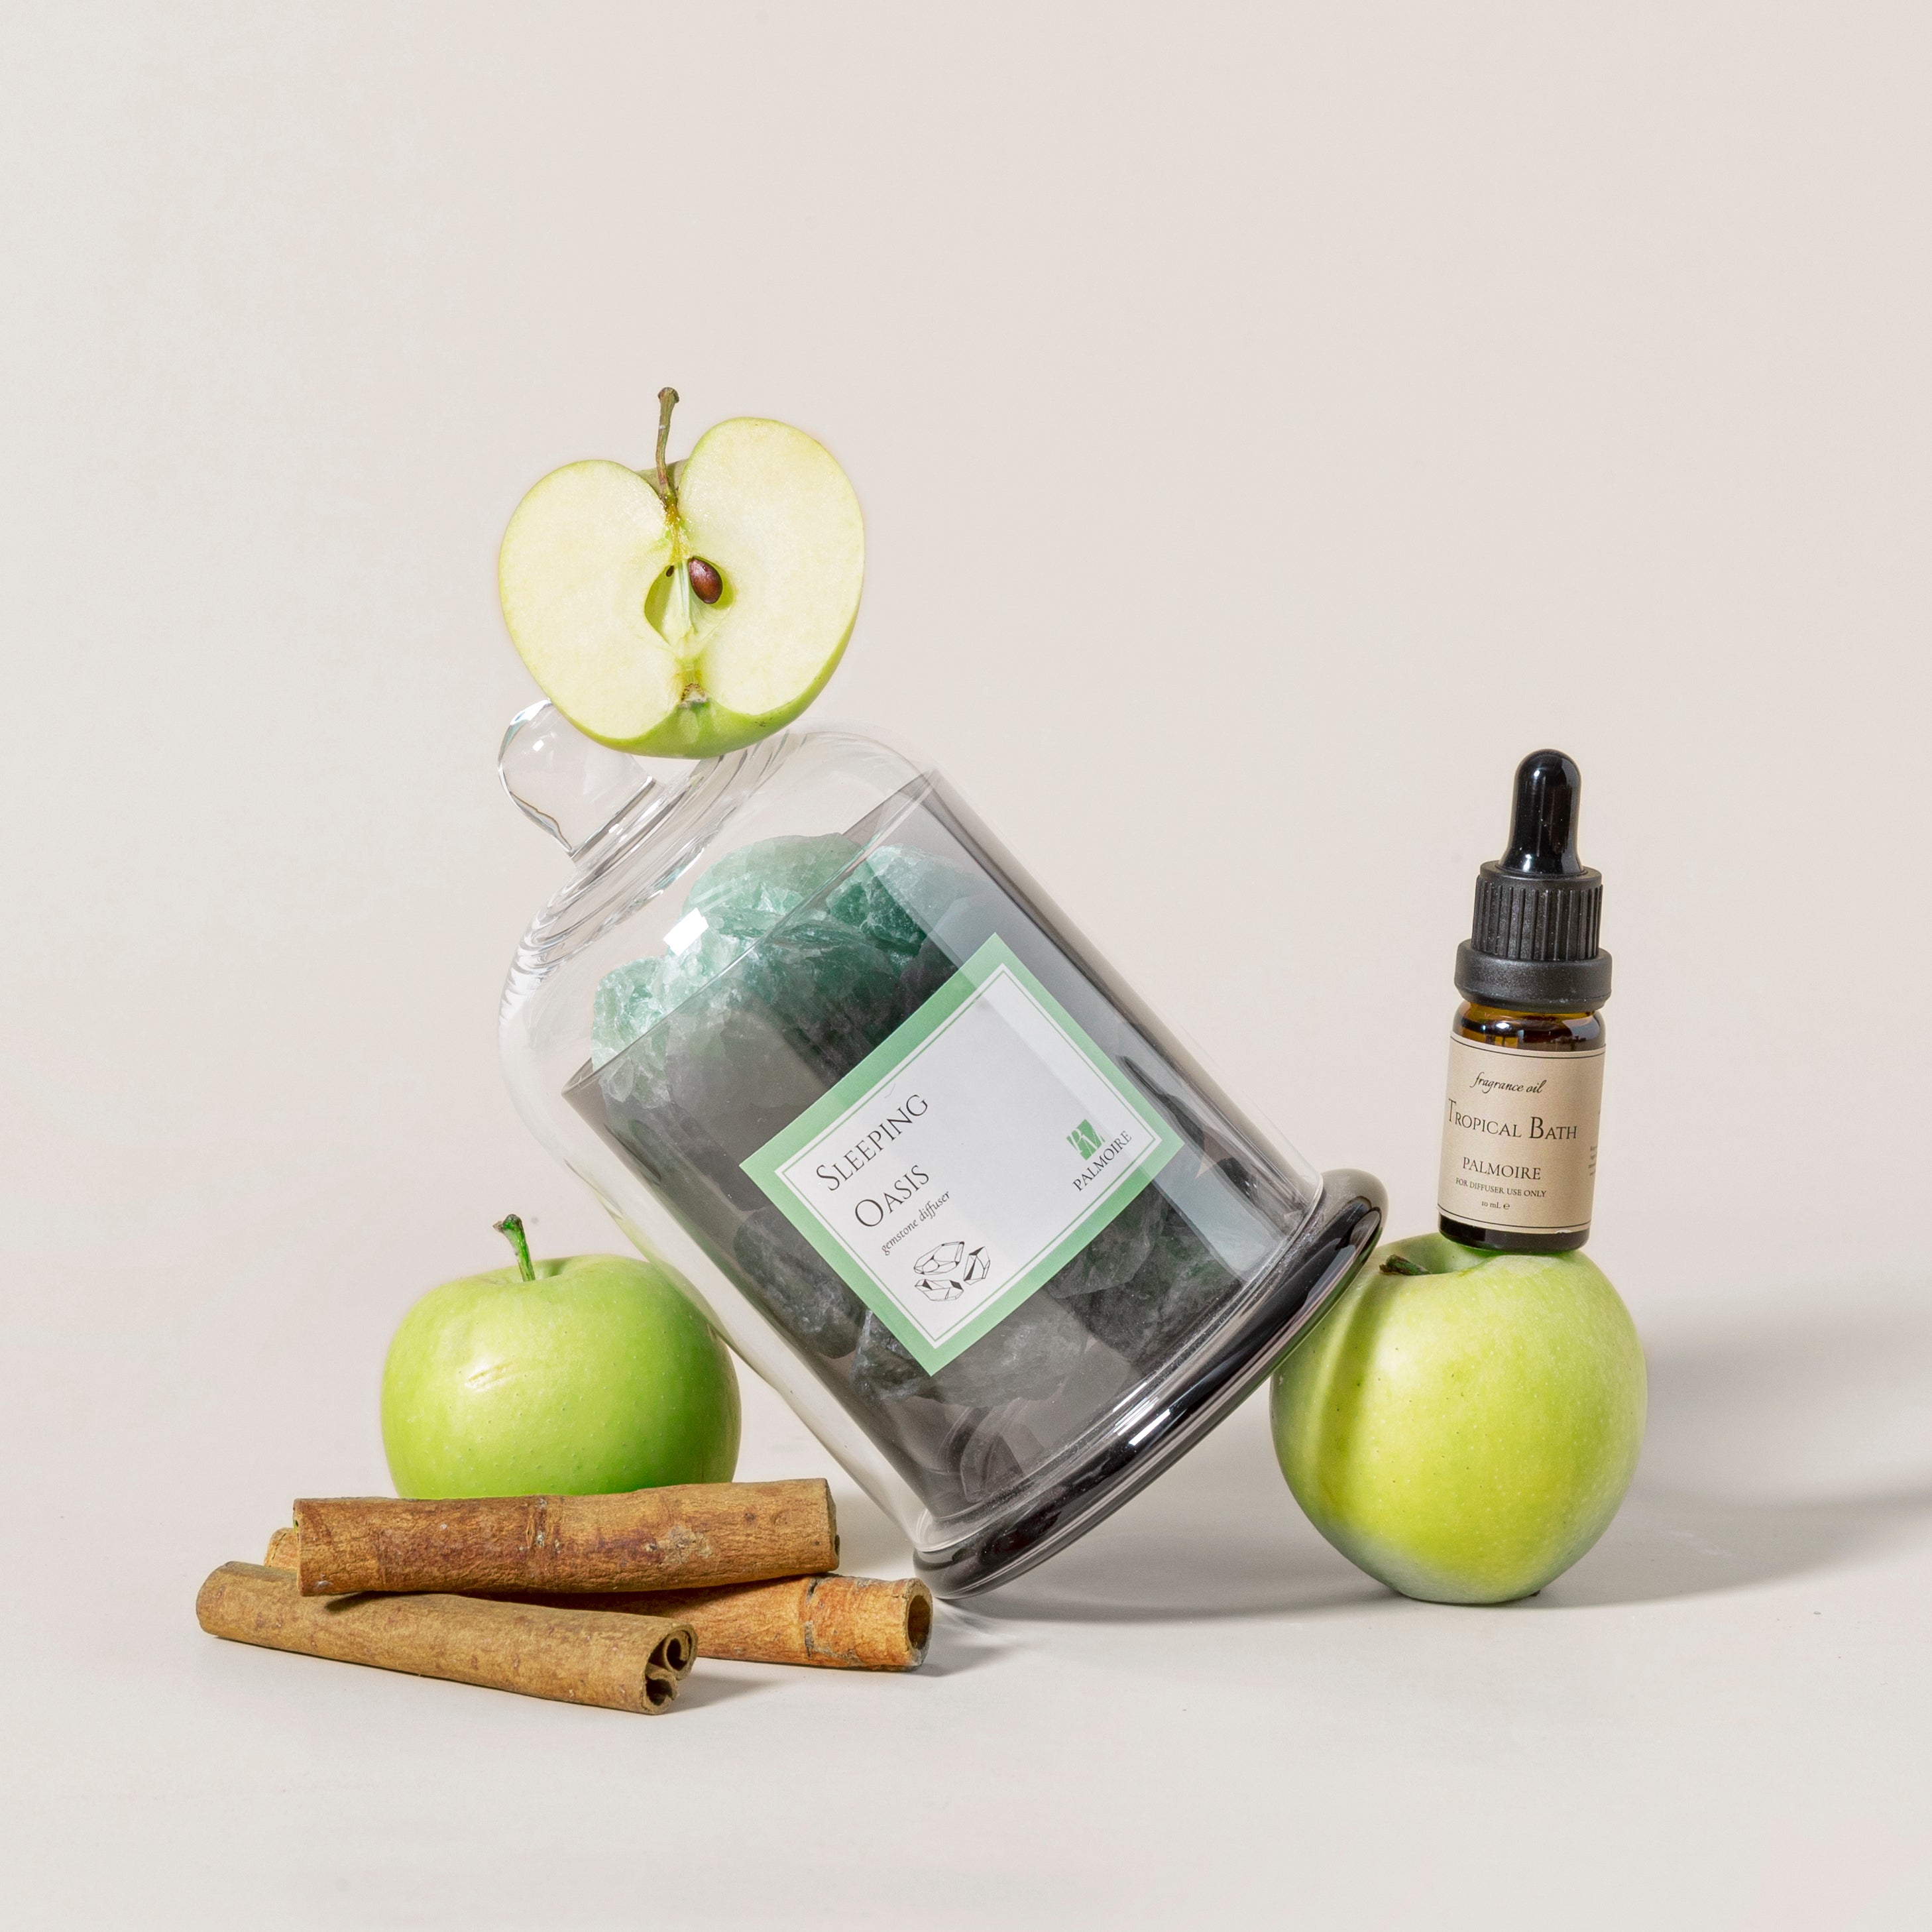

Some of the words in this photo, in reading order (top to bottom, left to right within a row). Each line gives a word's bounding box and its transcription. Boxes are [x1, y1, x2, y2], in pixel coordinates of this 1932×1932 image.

[1469, 1071, 1524, 1094] fragrance
[1526, 1080, 1547, 1094] oil
[816, 1094, 929, 1192] SLEEPING
[1448, 1098, 1522, 1138] TROPICAL
[1528, 1116, 1577, 1140] BATH
[1072, 1130, 1132, 1192] PALMOIRE
[1455, 1177, 1468, 1187] FOR
[1469, 1181, 1505, 1194] DIFFUSER
[1506, 1188, 1522, 1196] USE
[1462, 1157, 1542, 1180] PALMOIRE
[854, 1165, 929, 1227] OASIS
[881, 1219, 919, 1256] gemstone
[918, 1191, 950, 1222] diffuser
